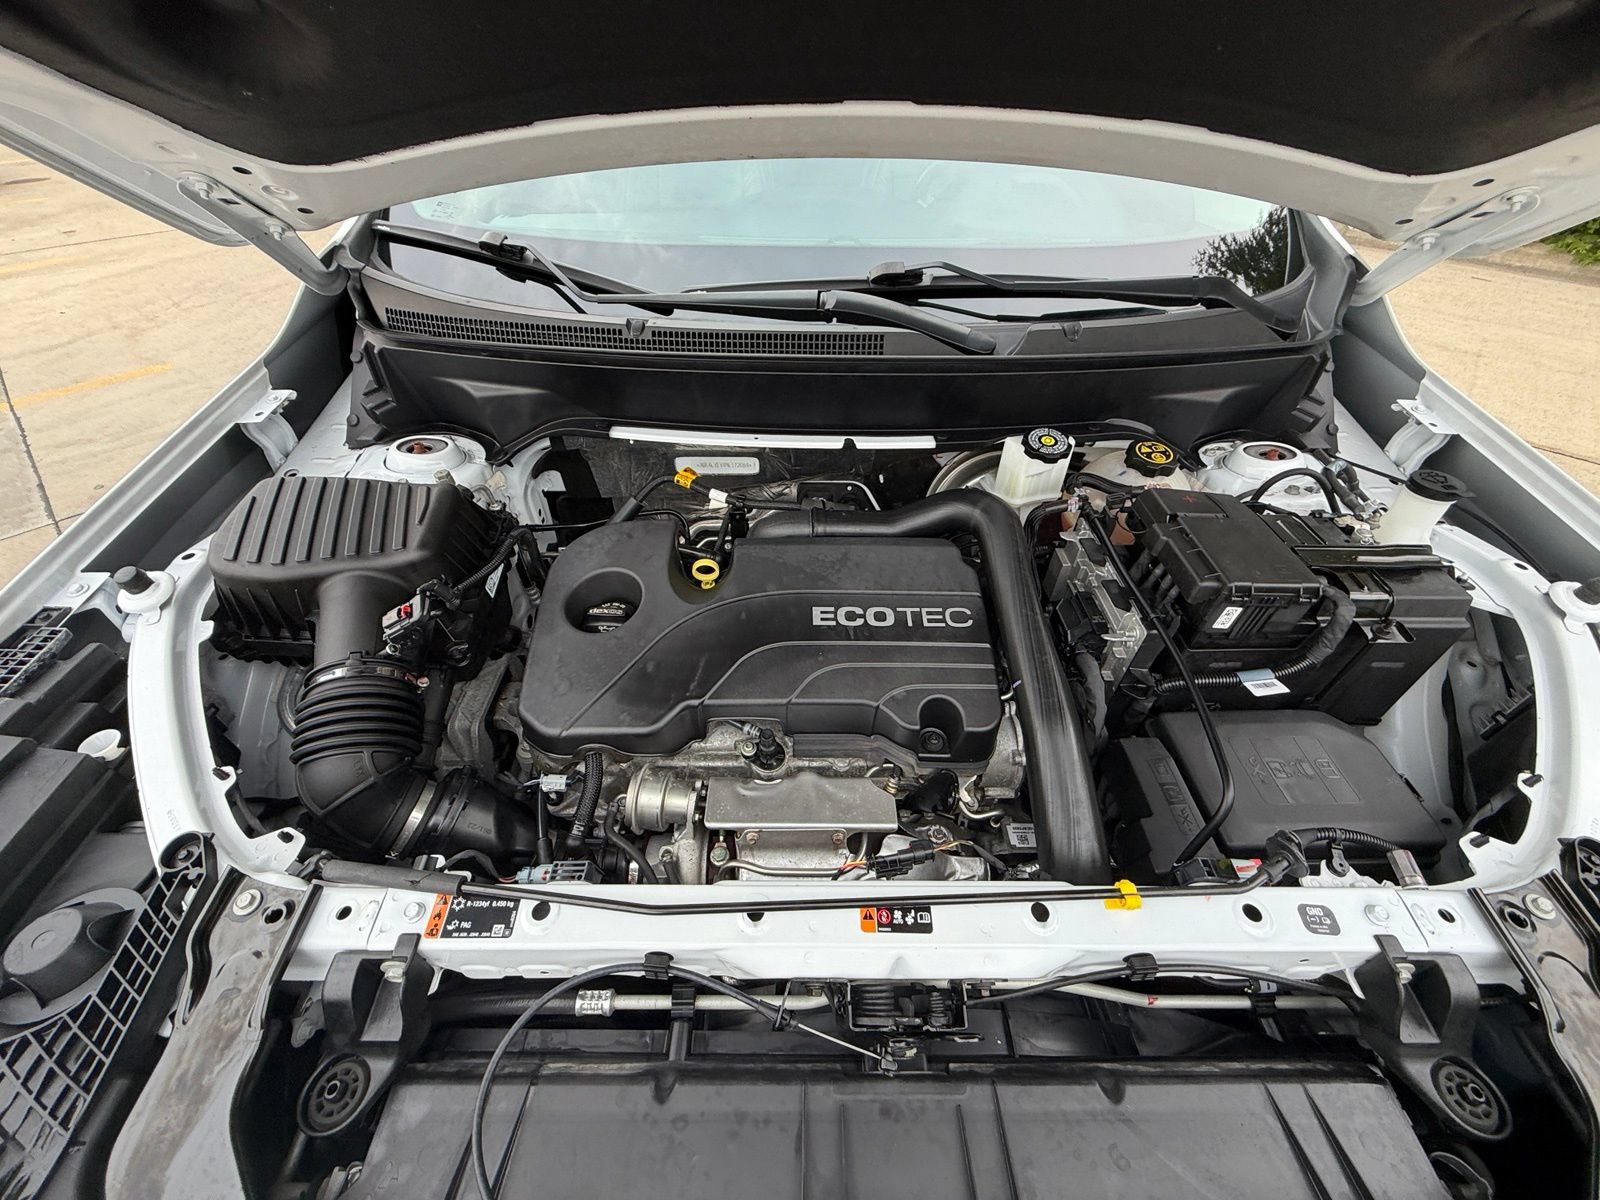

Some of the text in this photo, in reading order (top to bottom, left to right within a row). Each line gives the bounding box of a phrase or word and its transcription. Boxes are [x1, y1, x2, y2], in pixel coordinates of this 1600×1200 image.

[812, 606, 974, 628] ECOTEC
[1306, 906, 1324, 916] GND
[460, 921, 472, 929] PAG
